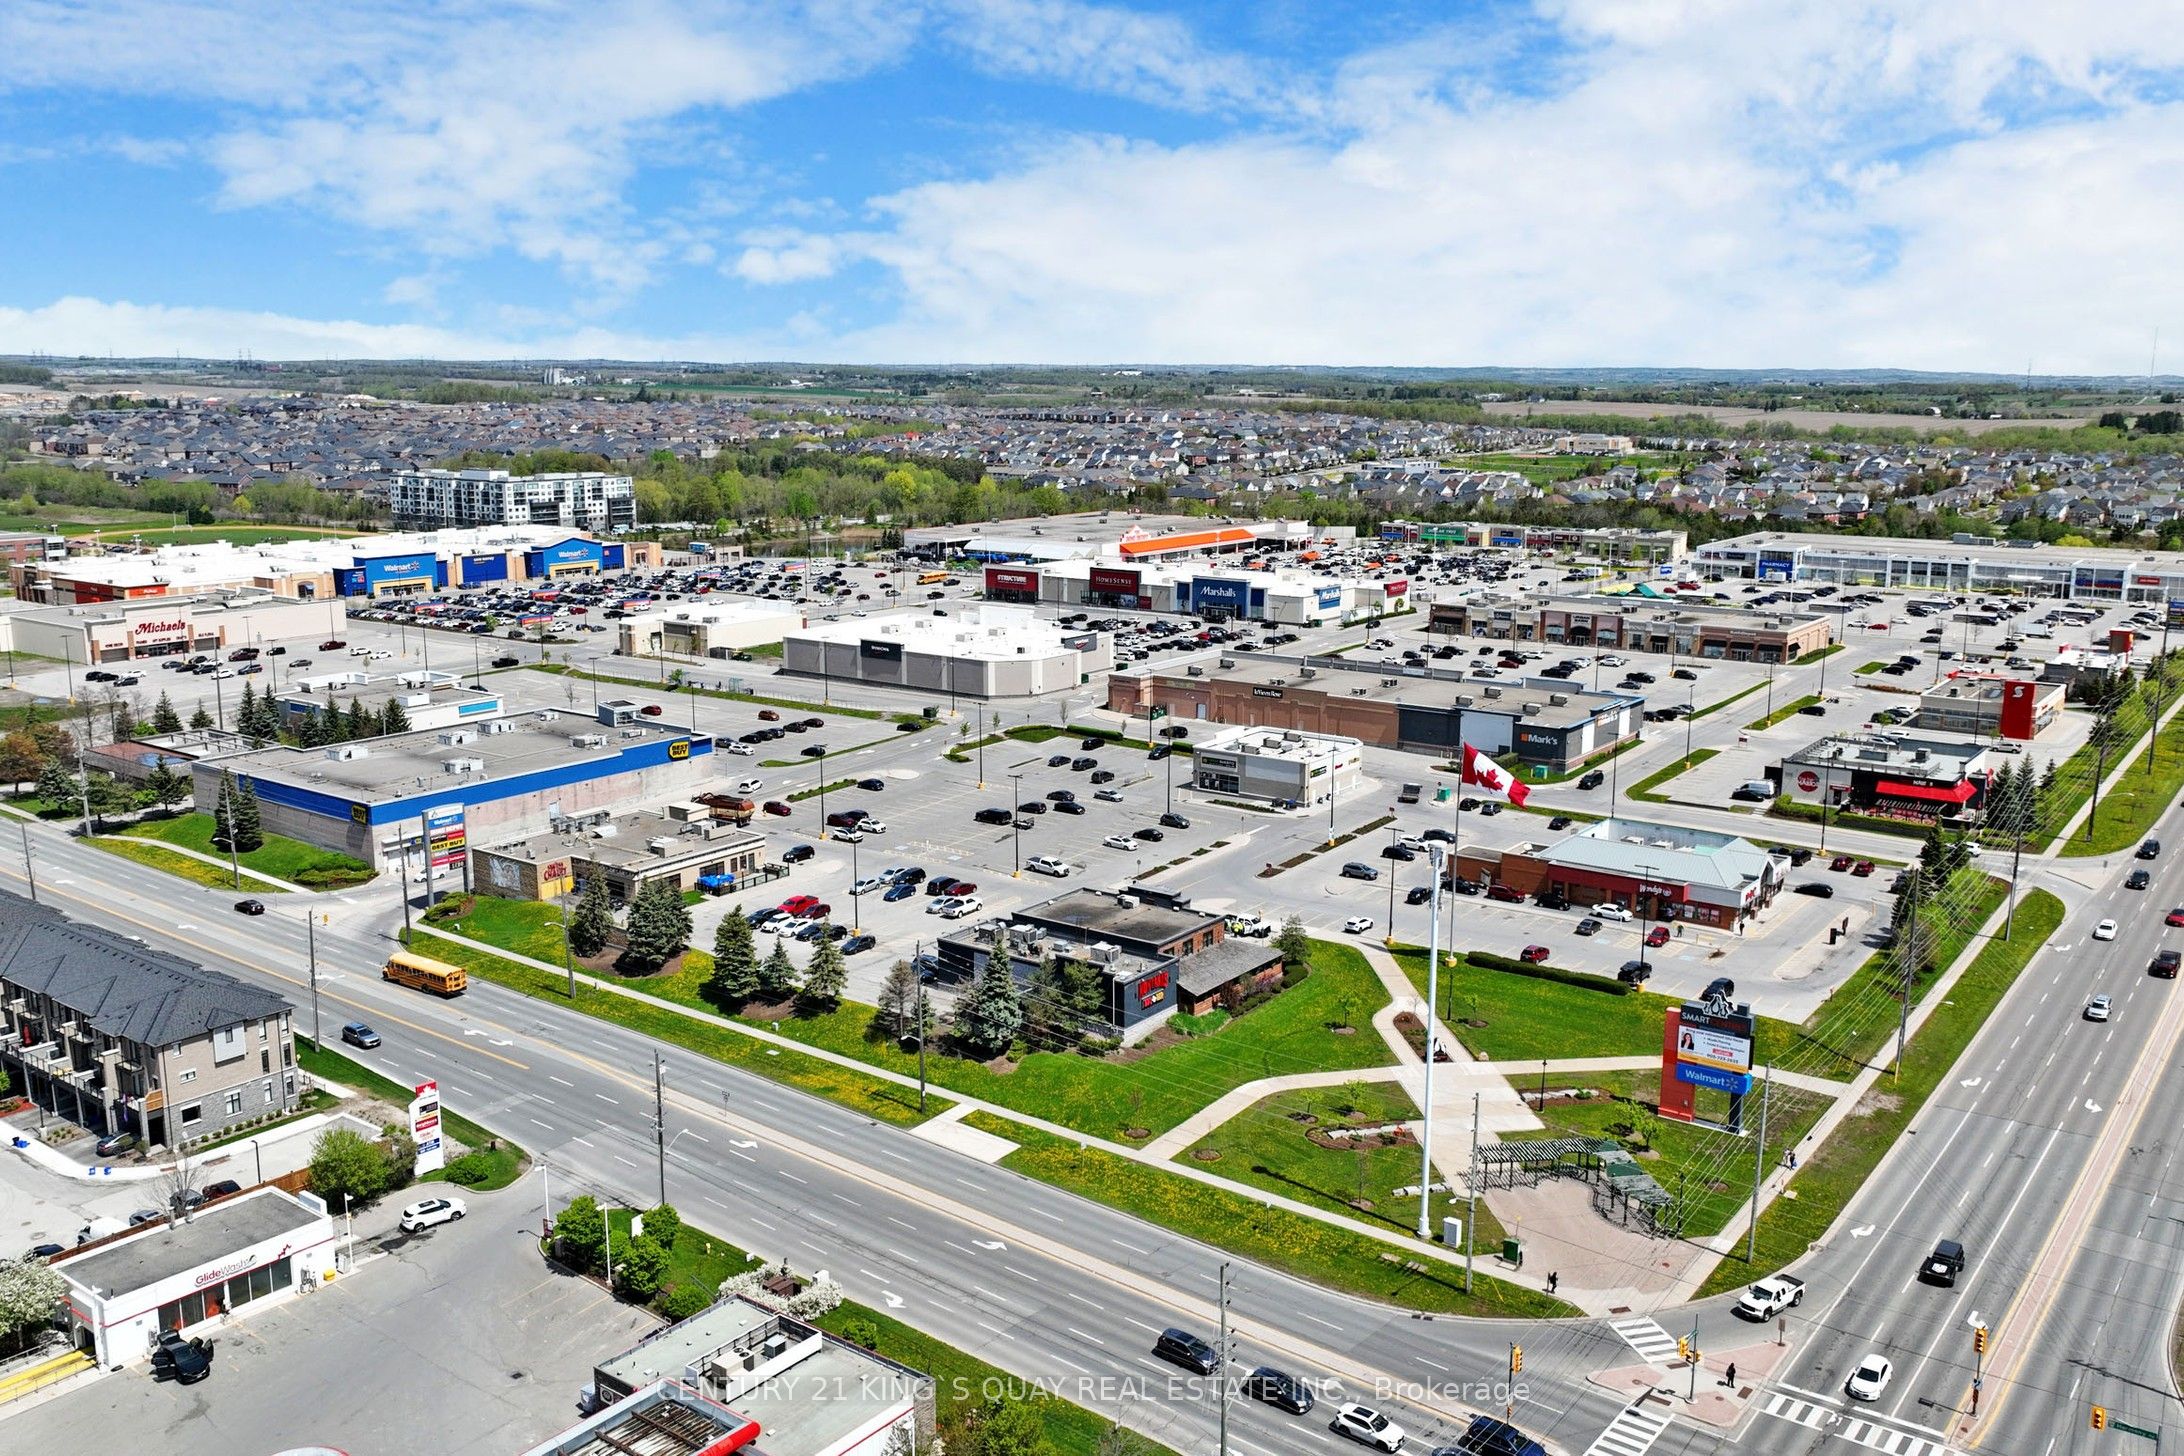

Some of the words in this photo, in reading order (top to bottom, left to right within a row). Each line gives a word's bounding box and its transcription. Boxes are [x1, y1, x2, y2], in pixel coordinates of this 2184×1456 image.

[384, 564, 411, 572] Walmart
[1200, 585, 1236, 598] Marshalls
[134, 619, 186, 635] Michaels
[1528, 734, 1558, 745] Mark's
[450, 839, 463, 847] BUY
[1686, 1070, 1725, 1086] Walmart
[196, 1258, 246, 1284] GlideWash
